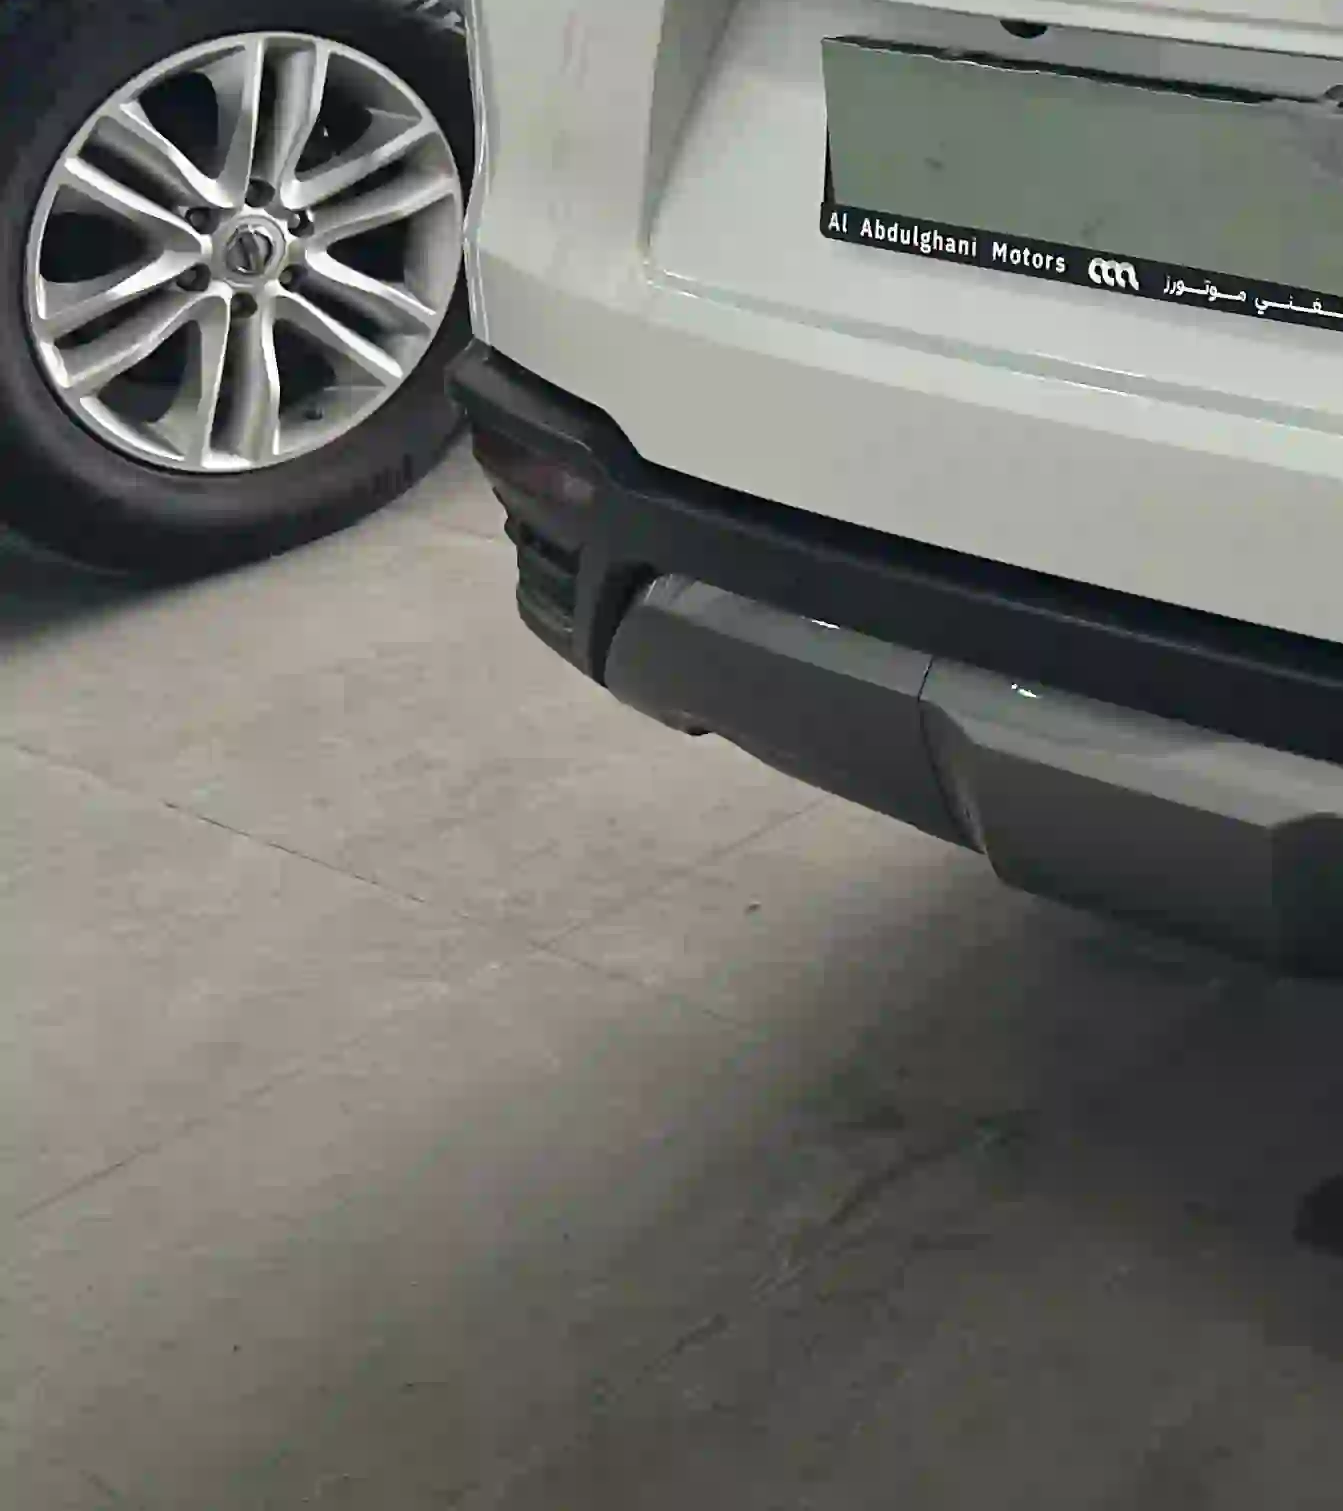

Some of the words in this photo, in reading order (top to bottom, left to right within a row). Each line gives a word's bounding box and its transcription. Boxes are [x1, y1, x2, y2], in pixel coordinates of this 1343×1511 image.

[828, 212, 848, 234] Al
[859, 216, 978, 257] Abdulghani
[991, 241, 1067, 274] Motors
[1163, 275, 1247, 302] موتورز
